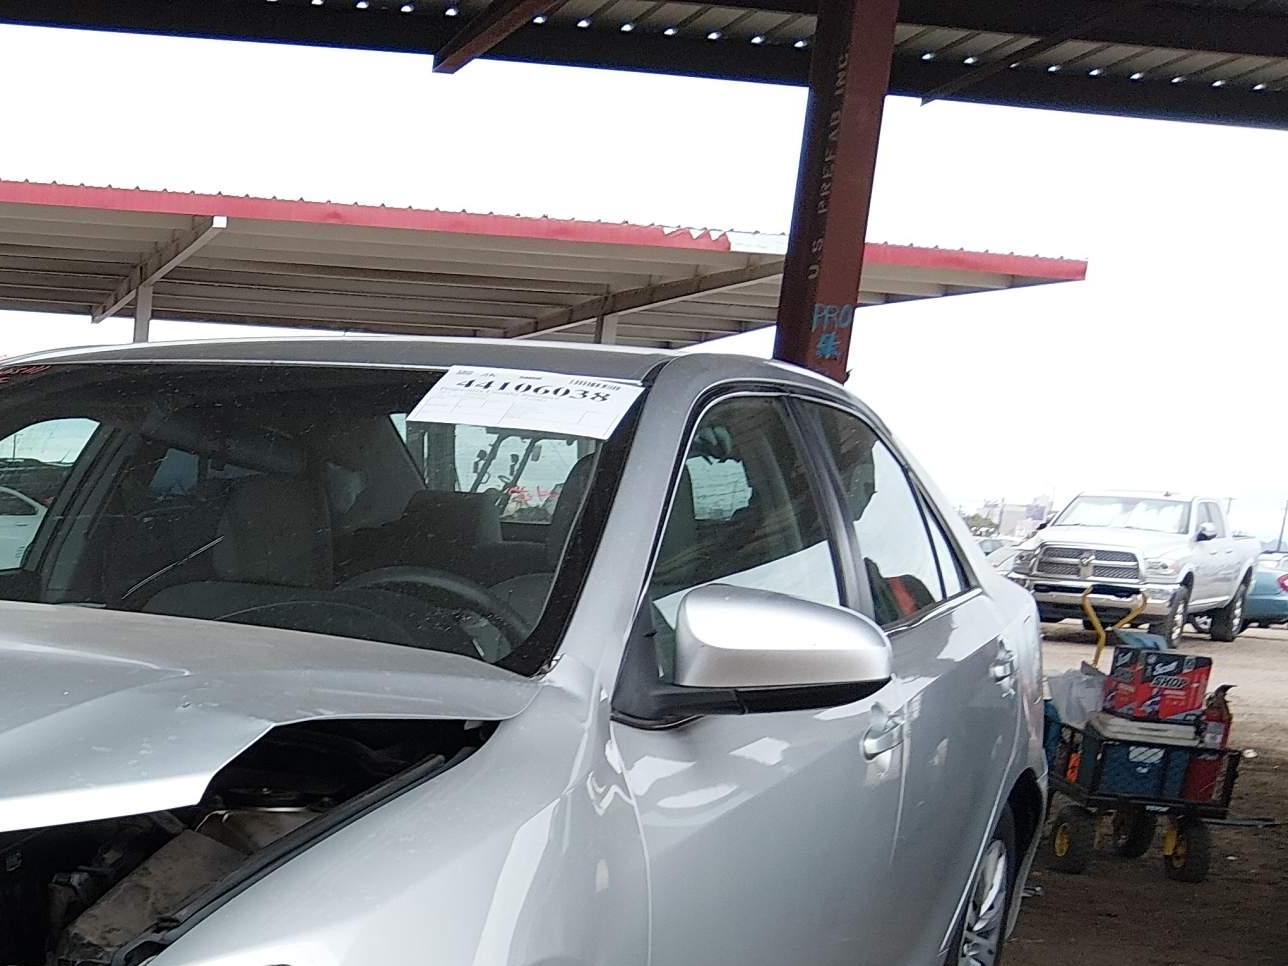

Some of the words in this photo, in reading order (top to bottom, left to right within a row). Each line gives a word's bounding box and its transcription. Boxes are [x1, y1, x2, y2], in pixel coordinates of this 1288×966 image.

[811, 303, 854, 333] PRO
[456, 379, 611, 402] 44106038
[1152, 675, 1188, 689] SHOP
